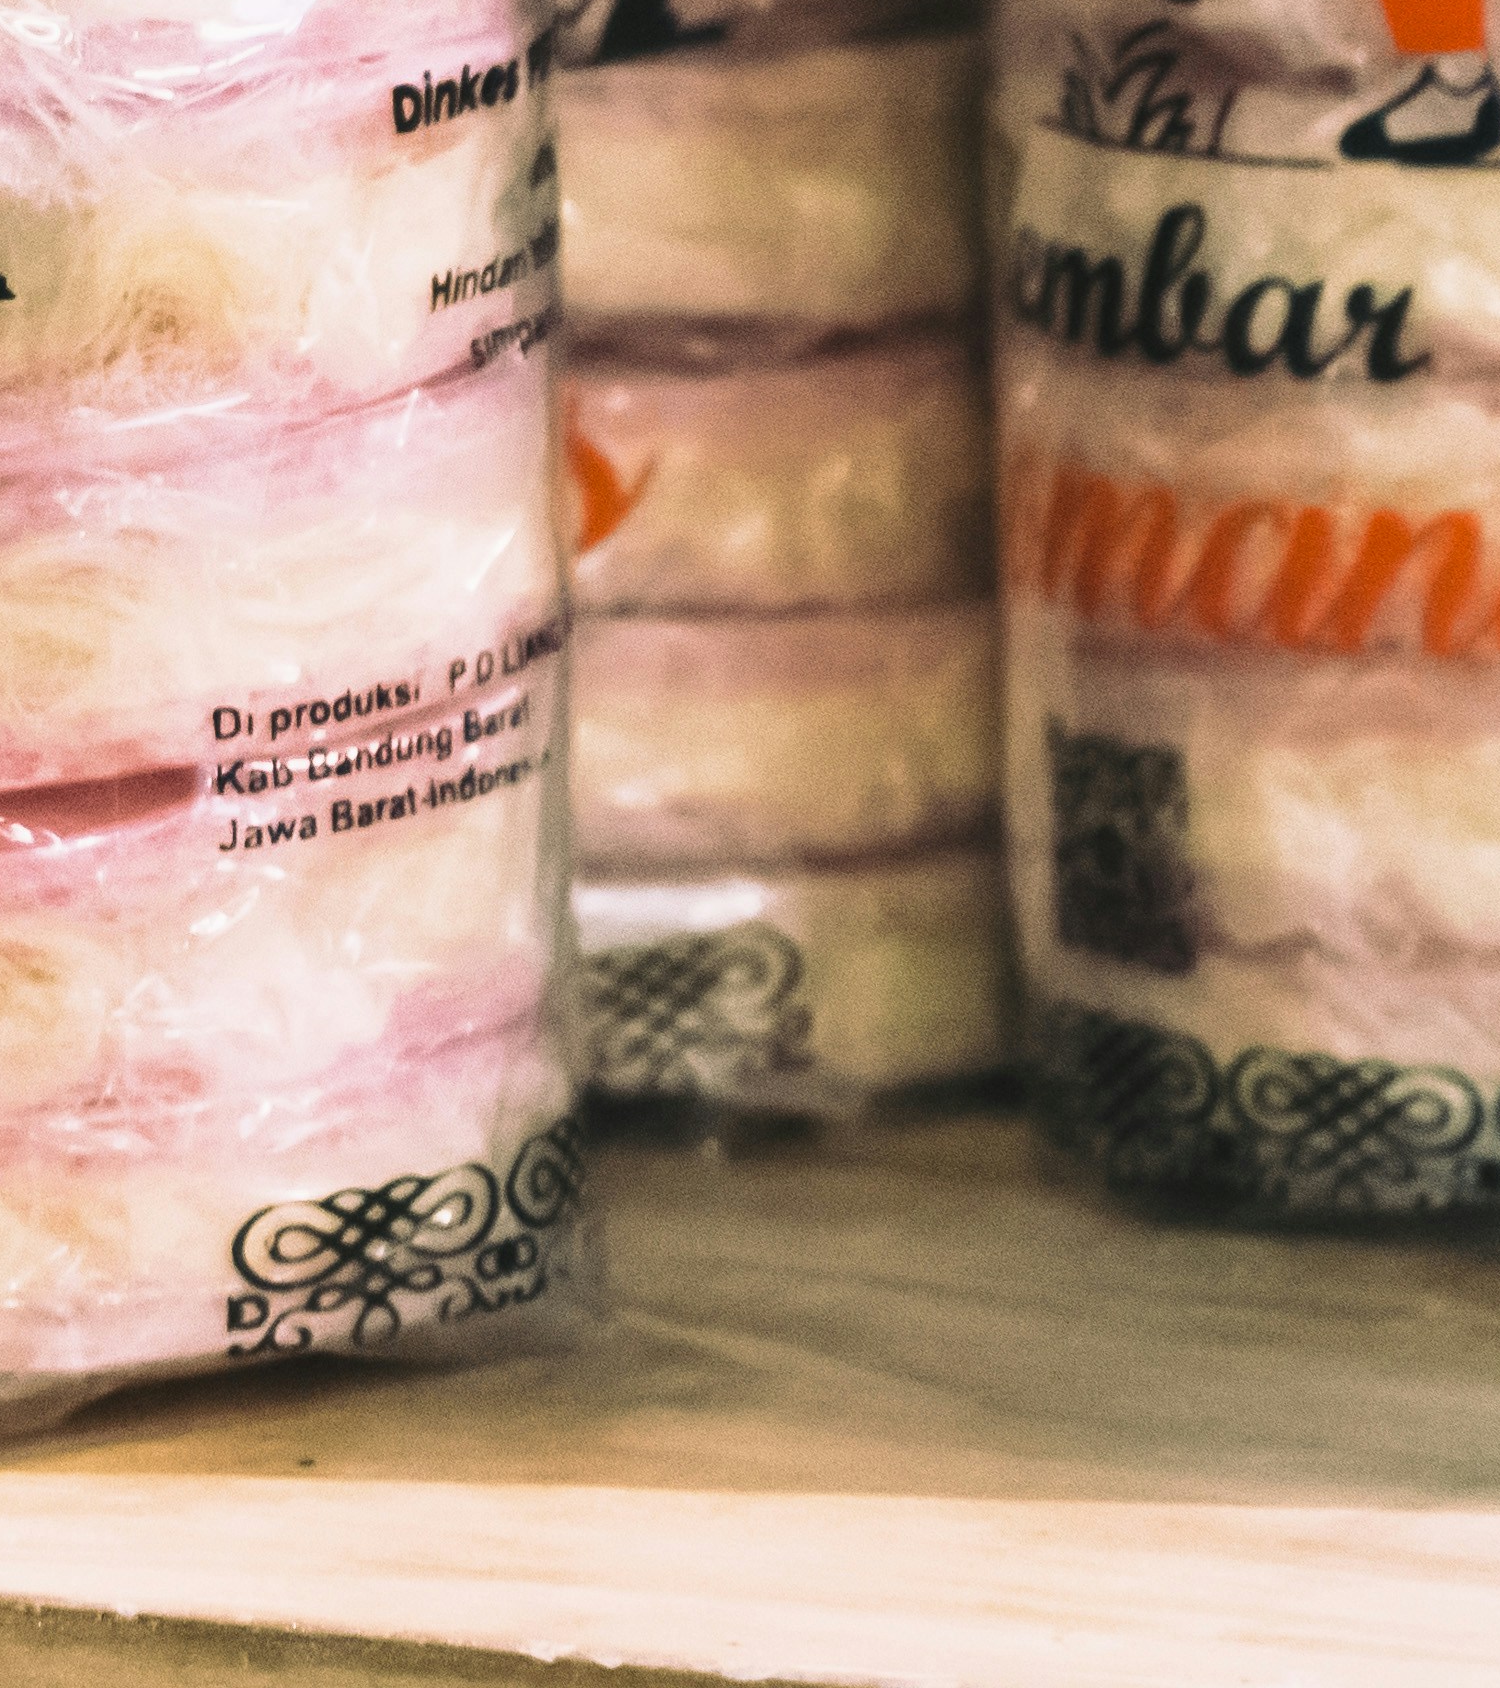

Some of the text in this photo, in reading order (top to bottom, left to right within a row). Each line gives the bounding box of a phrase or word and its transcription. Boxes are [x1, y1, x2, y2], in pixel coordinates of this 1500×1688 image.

[391, 58, 520, 135] Dinkes
[212, 706, 255, 741] Di
[215, 757, 294, 795] Kab
[307, 724, 454, 782] Bandung
[218, 818, 318, 852] Jawa
